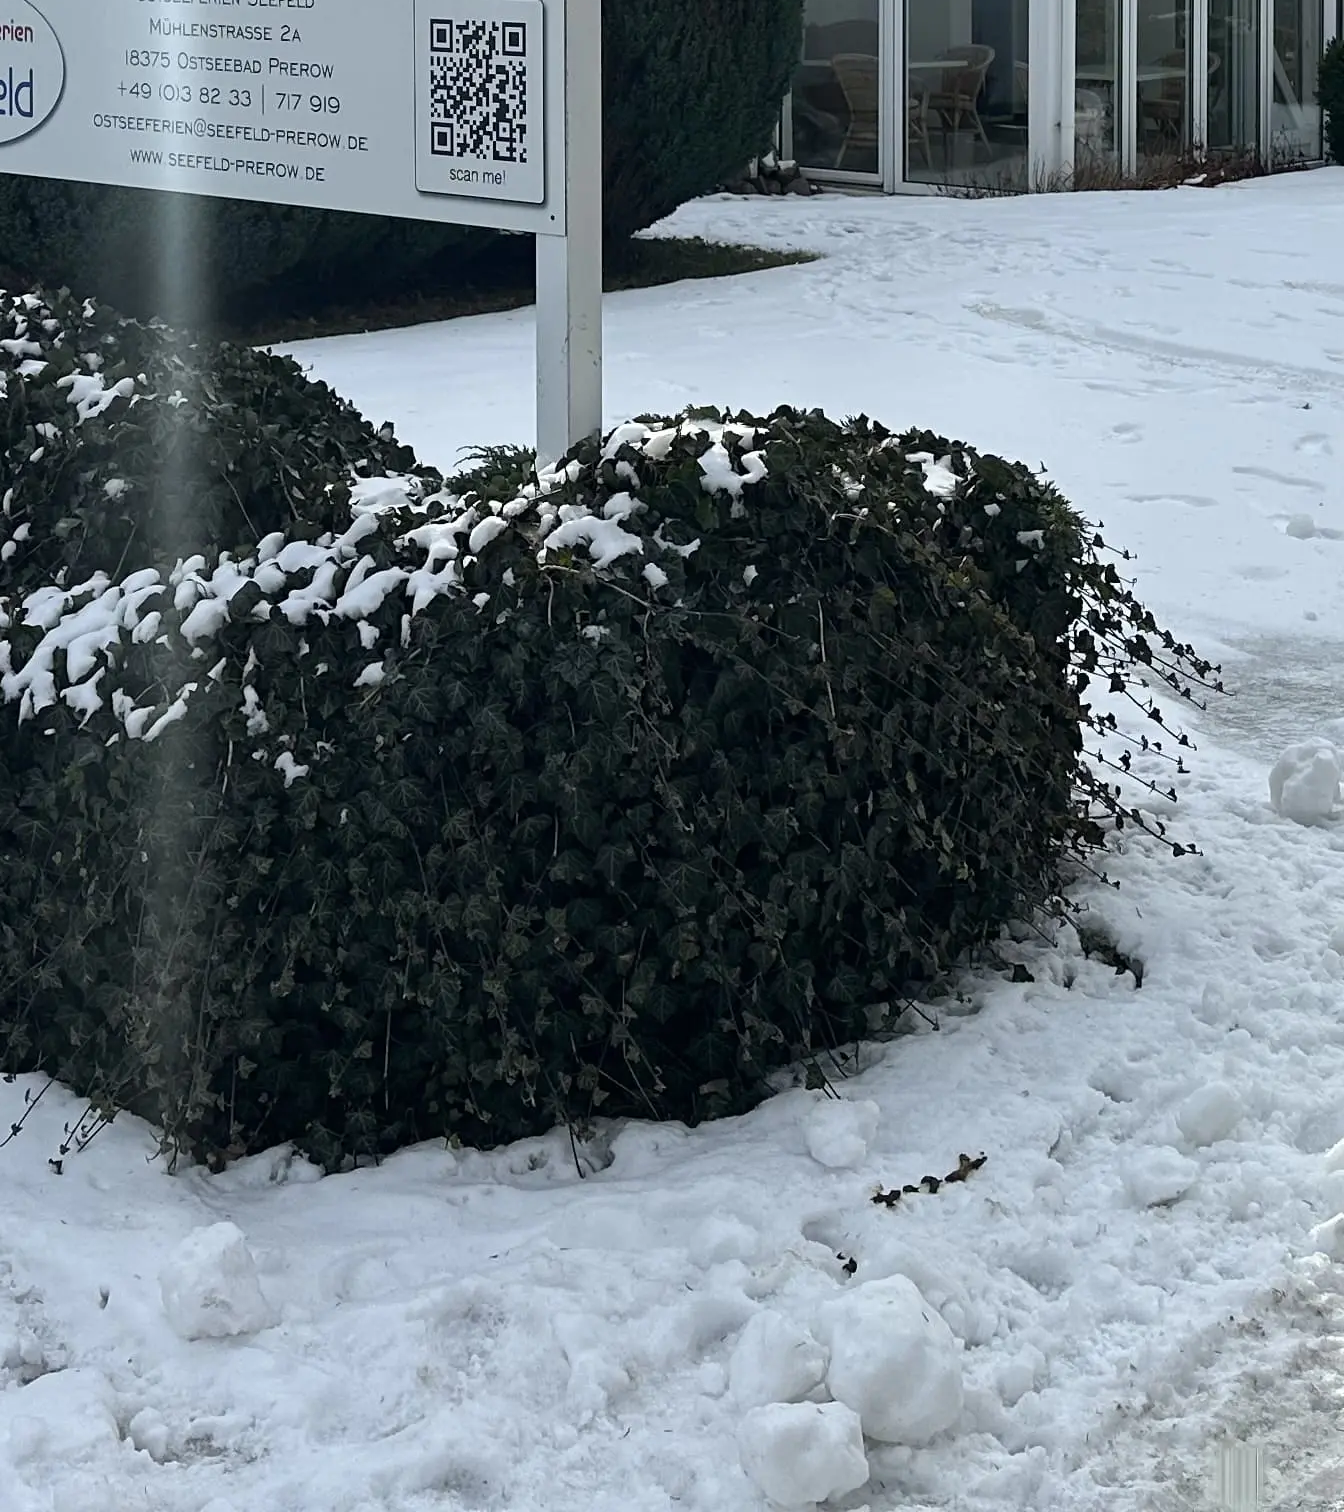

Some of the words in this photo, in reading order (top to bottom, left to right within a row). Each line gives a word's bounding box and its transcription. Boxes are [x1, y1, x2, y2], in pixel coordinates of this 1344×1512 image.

[125, 49, 171, 69] 18375
[117, 80, 152, 100] +49
[158, 83, 192, 103] (0)3
[199, 87, 221, 105] 82
[228, 89, 252, 107] 33
[275, 92, 302, 111] 717
[309, 95, 341, 114] 919
[449, 168, 479, 183] scan
[482, 170, 506, 185] me!
